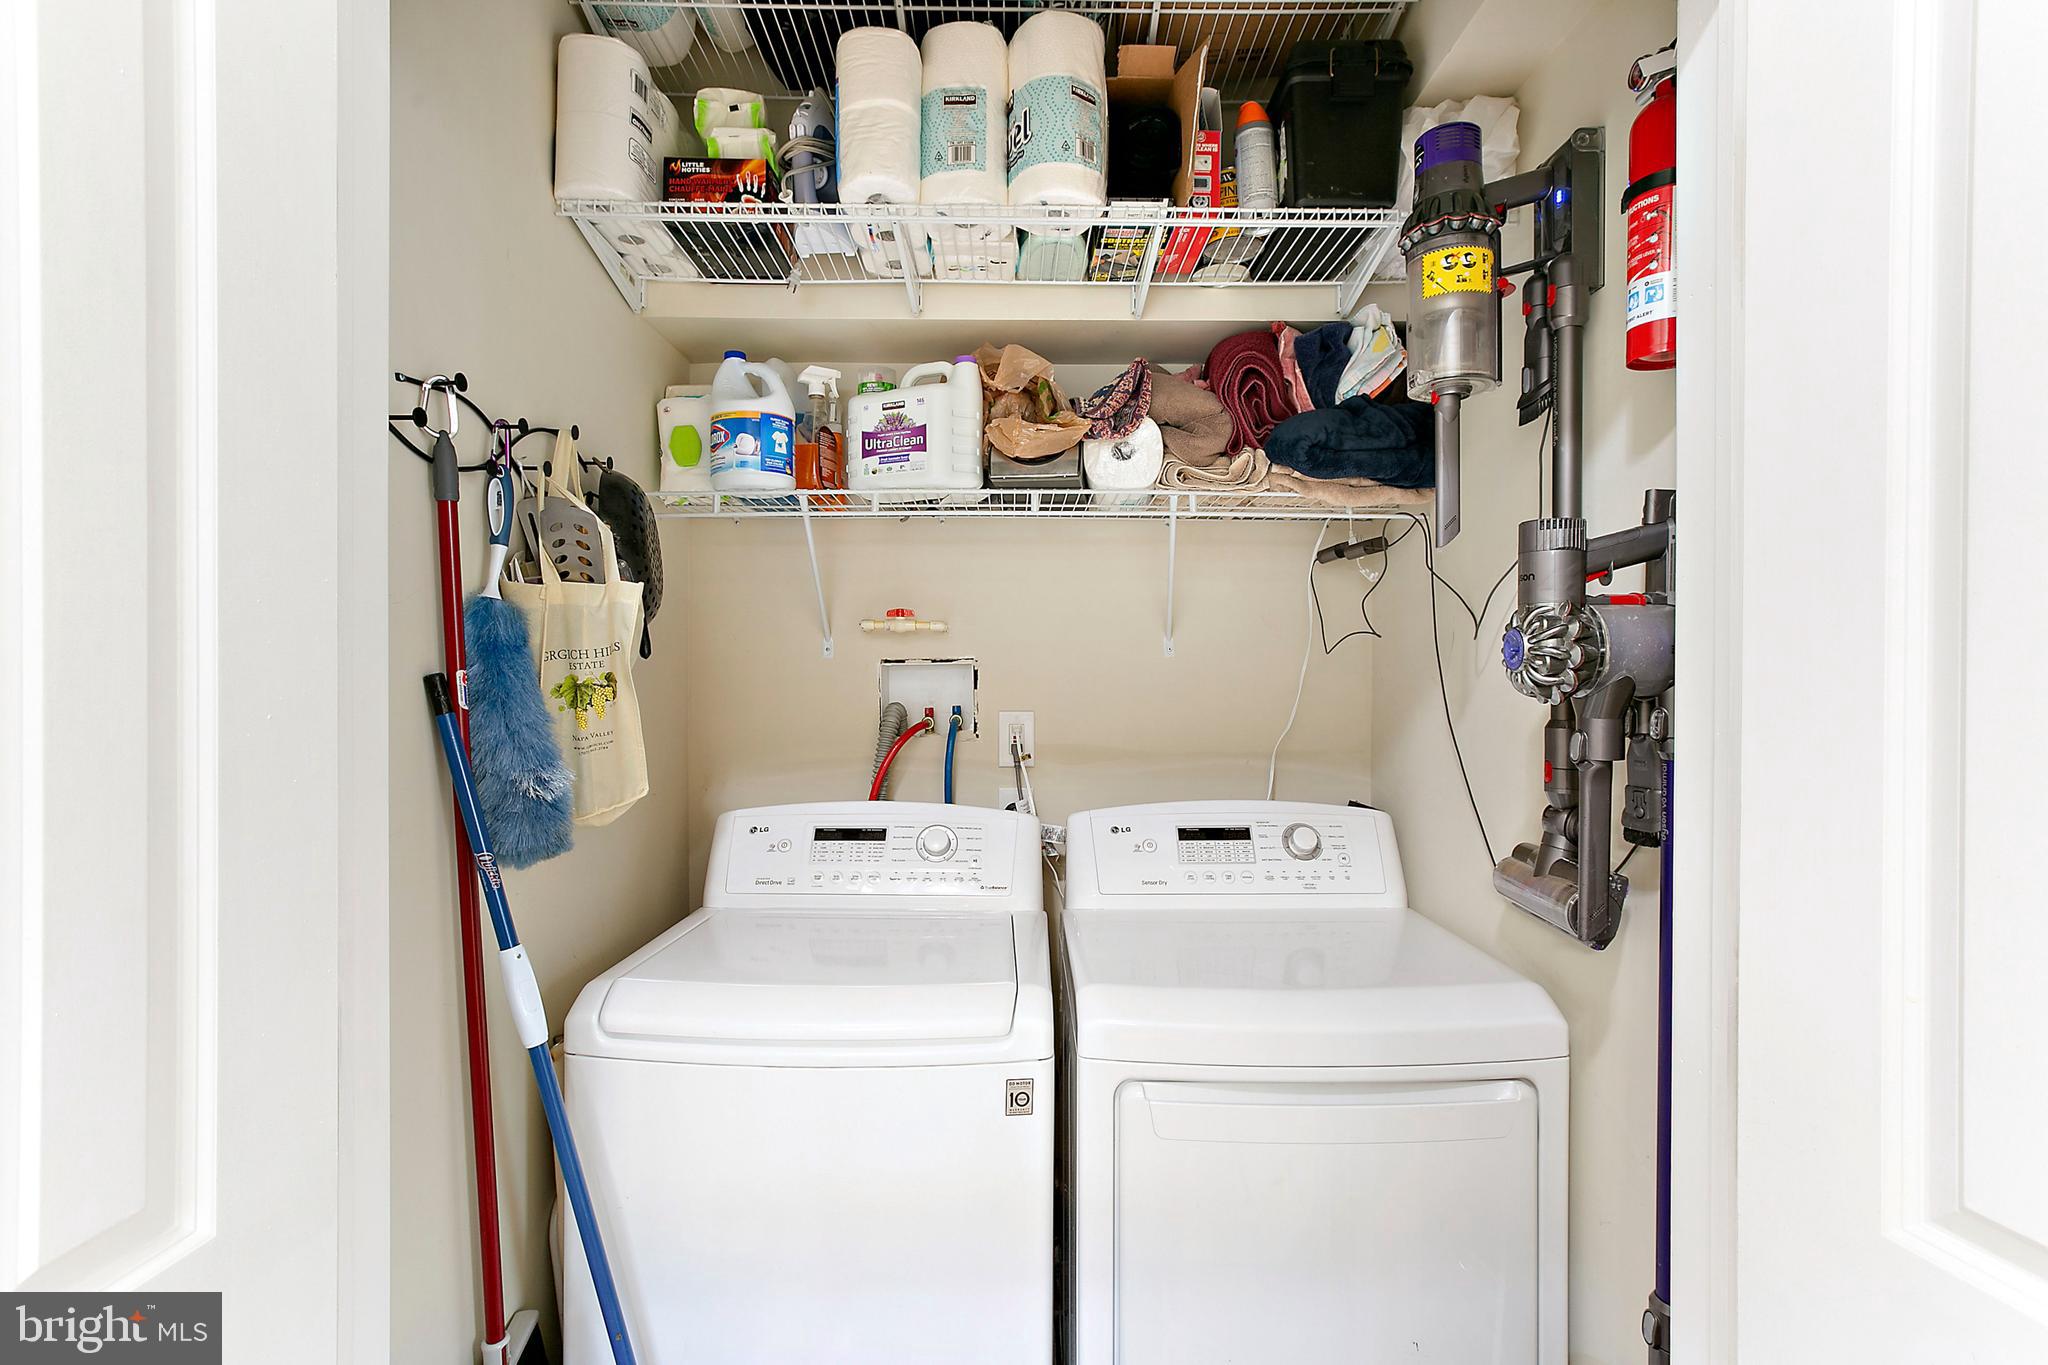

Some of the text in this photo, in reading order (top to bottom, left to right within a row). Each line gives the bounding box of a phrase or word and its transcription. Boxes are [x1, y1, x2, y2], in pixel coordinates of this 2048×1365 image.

[668, 177, 692, 185] HAND
[865, 435, 923, 451] UltraClean
[544, 641, 621, 662] GRGICH HILS
[569, 660, 605, 671] ESTATE
[1661, 809, 1669, 840] dyson
[474, 852, 501, 890] Quickie
